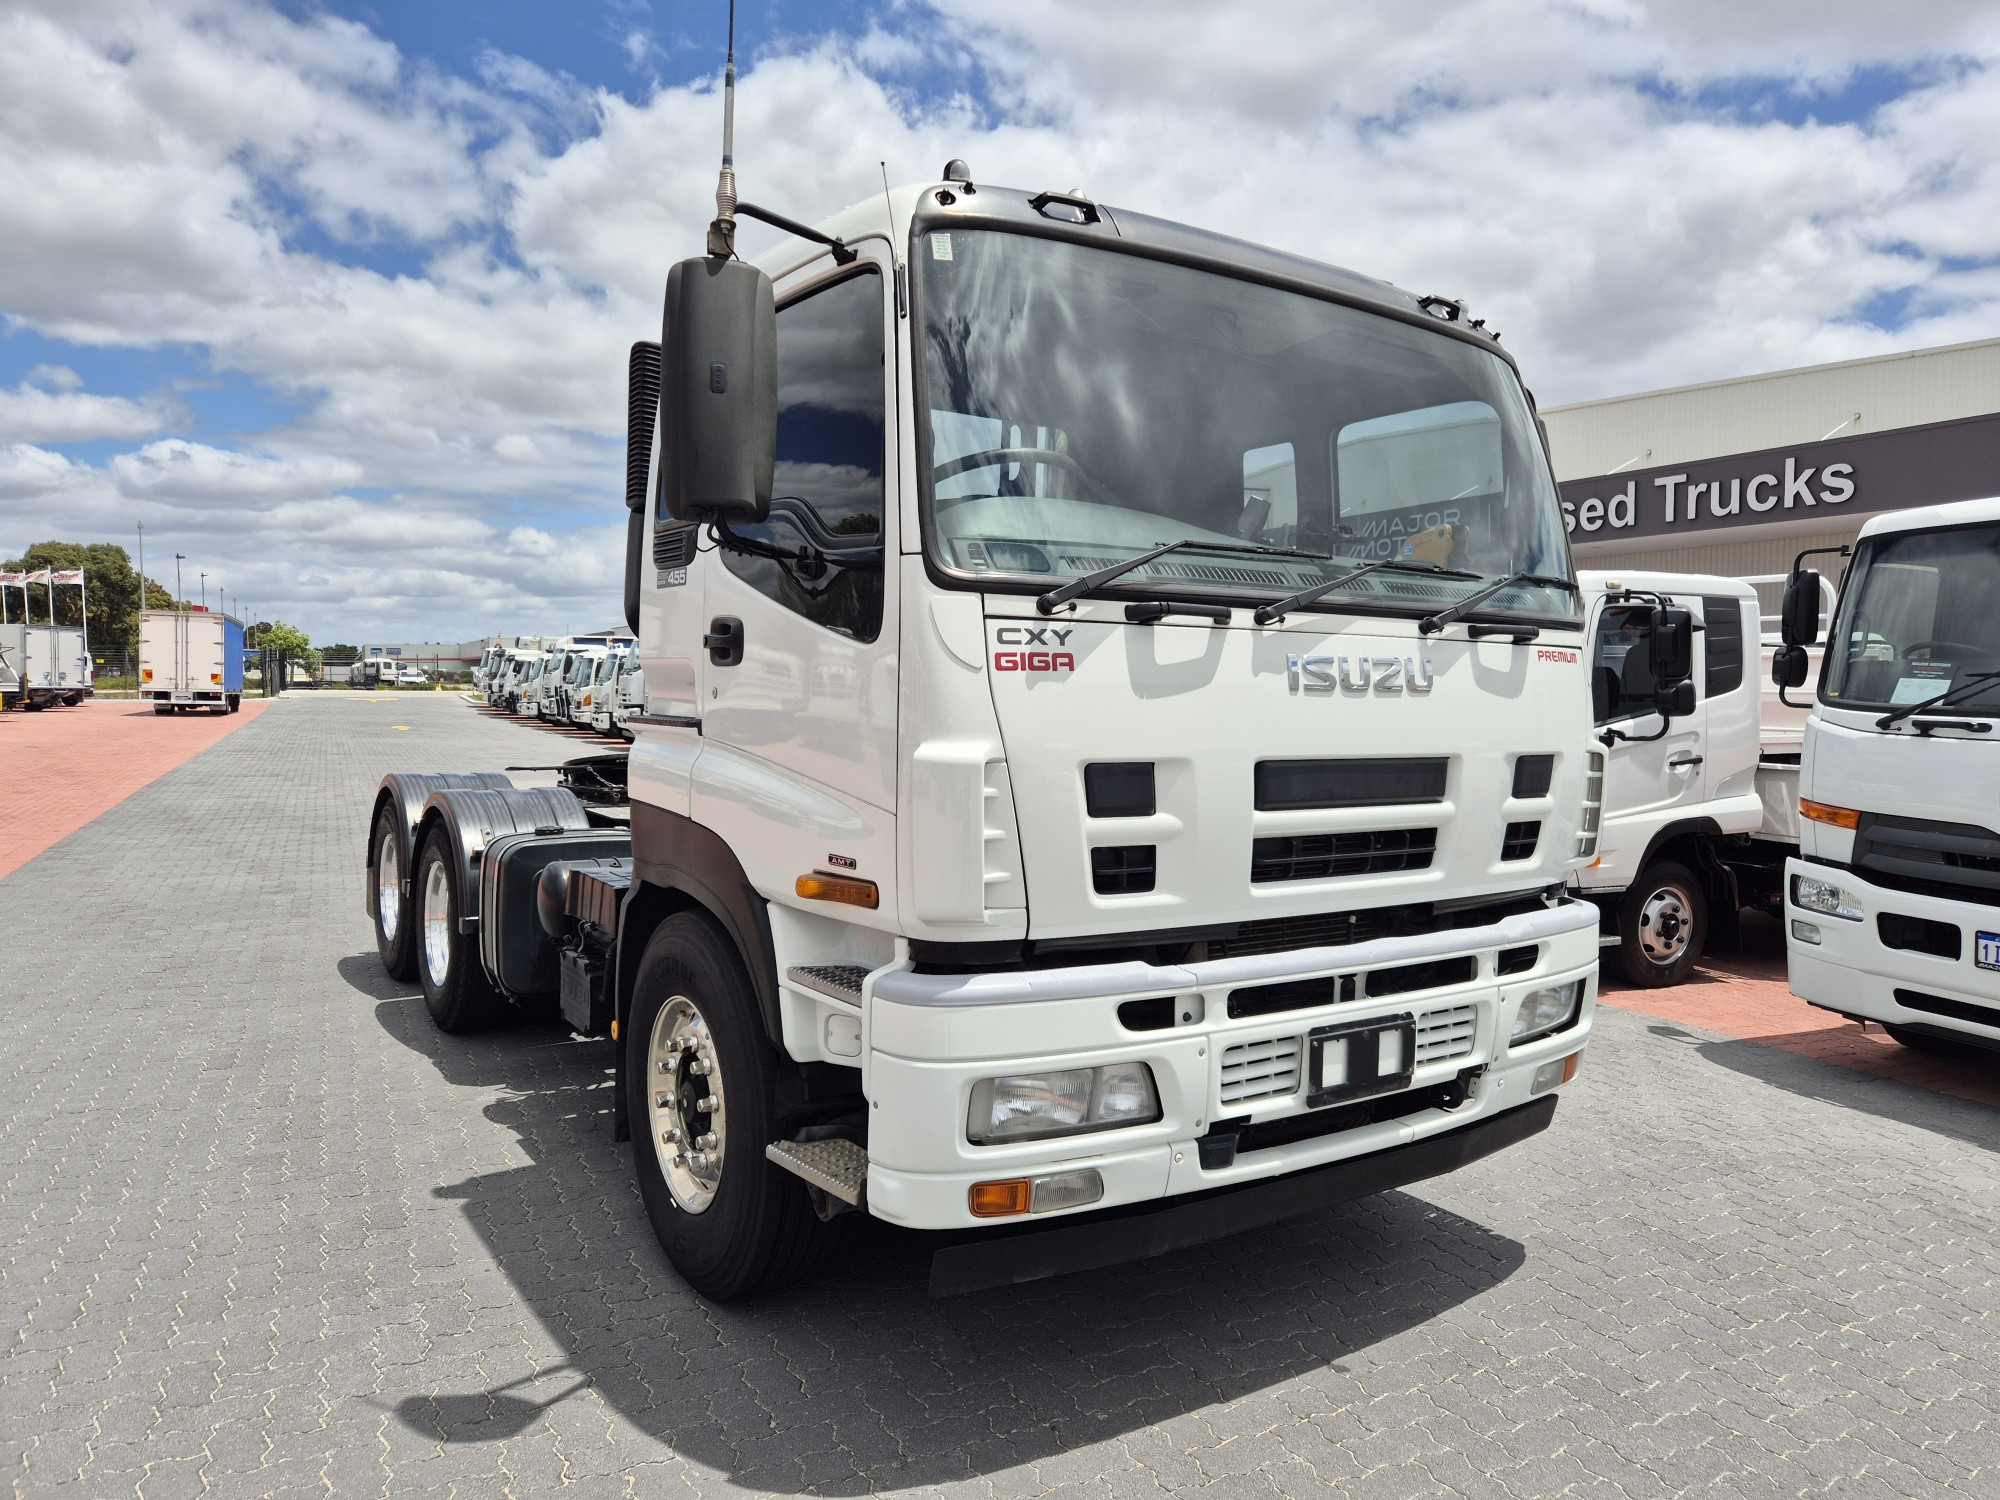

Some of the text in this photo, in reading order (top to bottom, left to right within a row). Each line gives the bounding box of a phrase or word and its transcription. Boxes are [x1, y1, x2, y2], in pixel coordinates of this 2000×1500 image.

[1654, 457, 1856, 523] Trucks
[1362, 508, 1461, 538] MAJOR
[1347, 535, 1408, 559] MOT
[668, 569, 686, 584] 455
[996, 627, 1073, 646] CXY
[994, 651, 1075, 671] GIGA
[1537, 650, 1577, 664] PREMIUM
[1286, 653, 1433, 693] ISUZU
[831, 857, 851, 867] AMT
